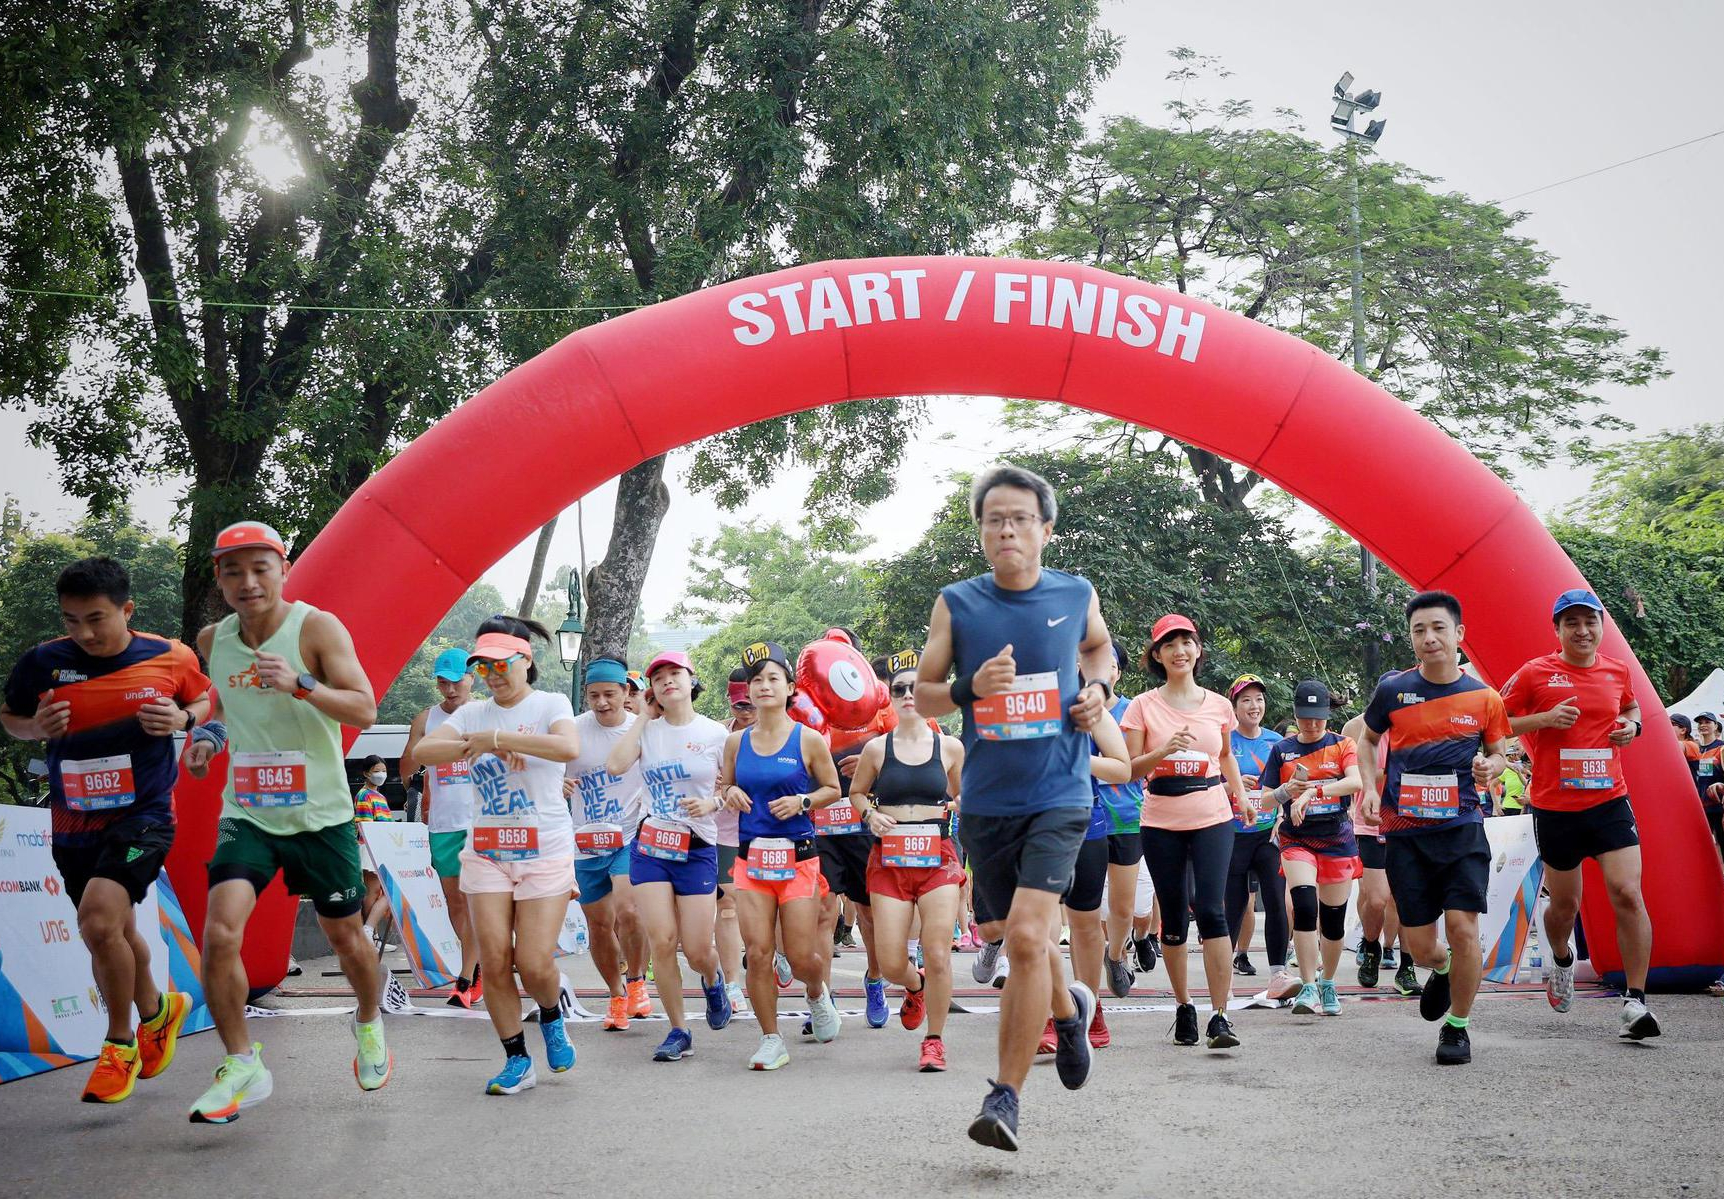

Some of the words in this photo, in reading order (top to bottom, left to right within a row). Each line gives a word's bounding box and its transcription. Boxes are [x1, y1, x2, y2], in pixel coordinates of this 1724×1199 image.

[728, 269, 927, 346] START
[945, 270, 976, 321] /
[993, 272, 1207, 364] FINISH
[1005, 692, 1047, 716] 9640
[452, 761, 468, 773] 960
[470, 757, 506, 785] UNT
[642, 763, 691, 786] UNTIL
[1174, 762, 1200, 774] 9626
[1582, 760, 1606, 773] 9636
[85, 771, 121, 791] 9662
[258, 767, 293, 786] 9645
[478, 775, 509, 802] WE
[580, 787, 607, 806] WE
[648, 781, 674, 801] WE
[1421, 787, 1449, 802] 9600
[481, 788, 535, 816] HEAL
[584, 798, 623, 820] HEAL
[829, 808, 852, 821] 9656
[498, 829, 528, 844] 9658
[593, 832, 615, 845] 9657
[656, 831, 682, 846] 9660
[904, 837, 932, 851] 9667
[762, 850, 788, 864] 9689
[0, 880, 43, 893] COMBANK
